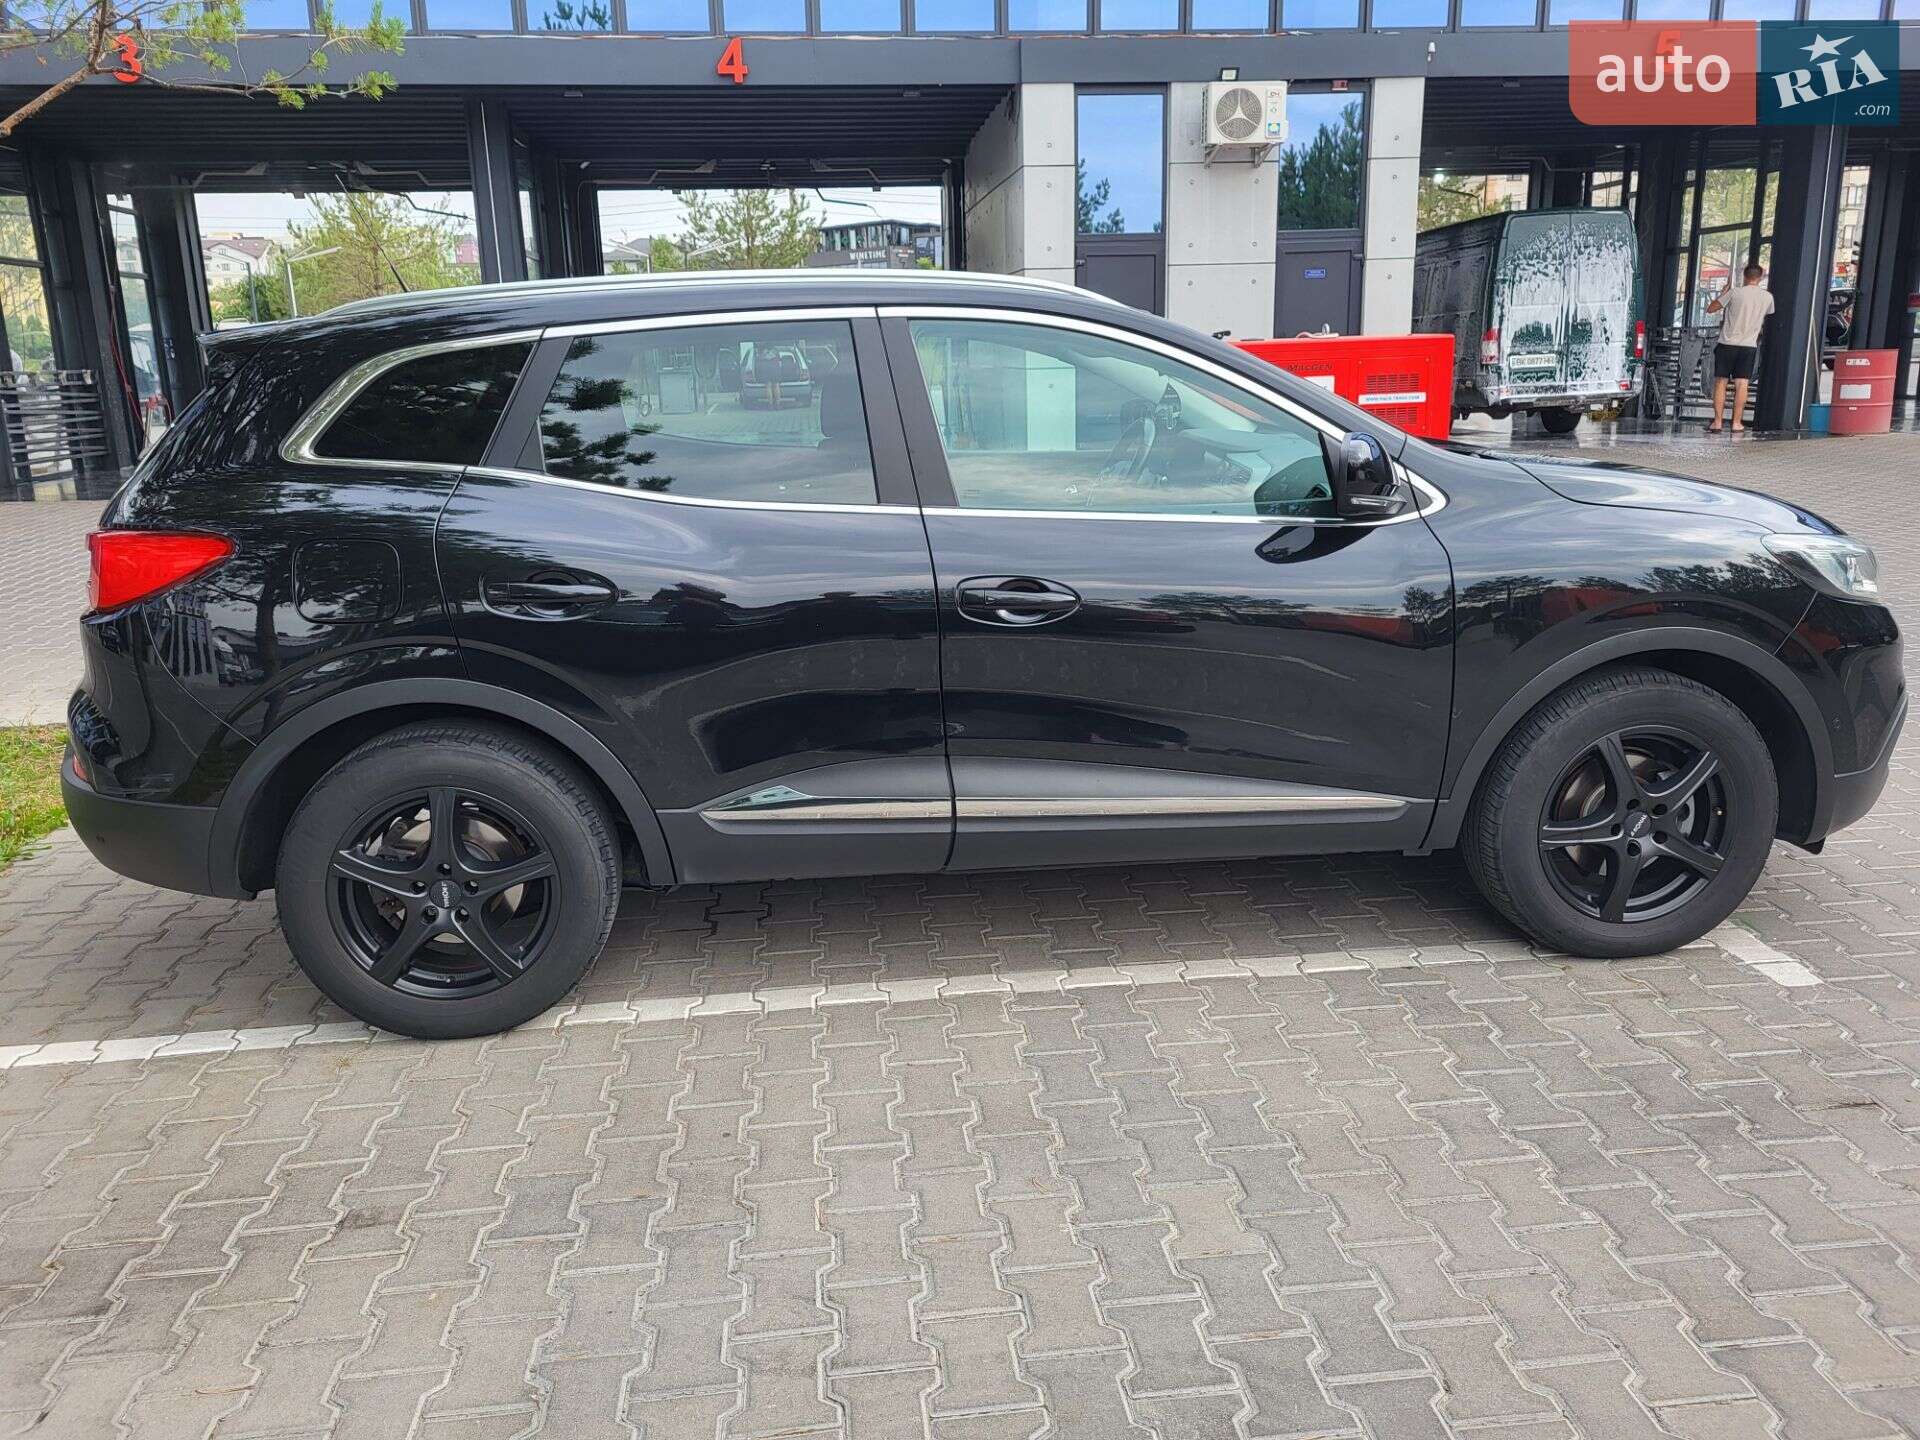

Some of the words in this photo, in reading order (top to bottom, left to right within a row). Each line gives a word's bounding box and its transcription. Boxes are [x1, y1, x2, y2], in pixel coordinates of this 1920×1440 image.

[112, 33, 142, 83] 3
[717, 36, 748, 83] 4
[849, 249, 887, 261] WINETIME
